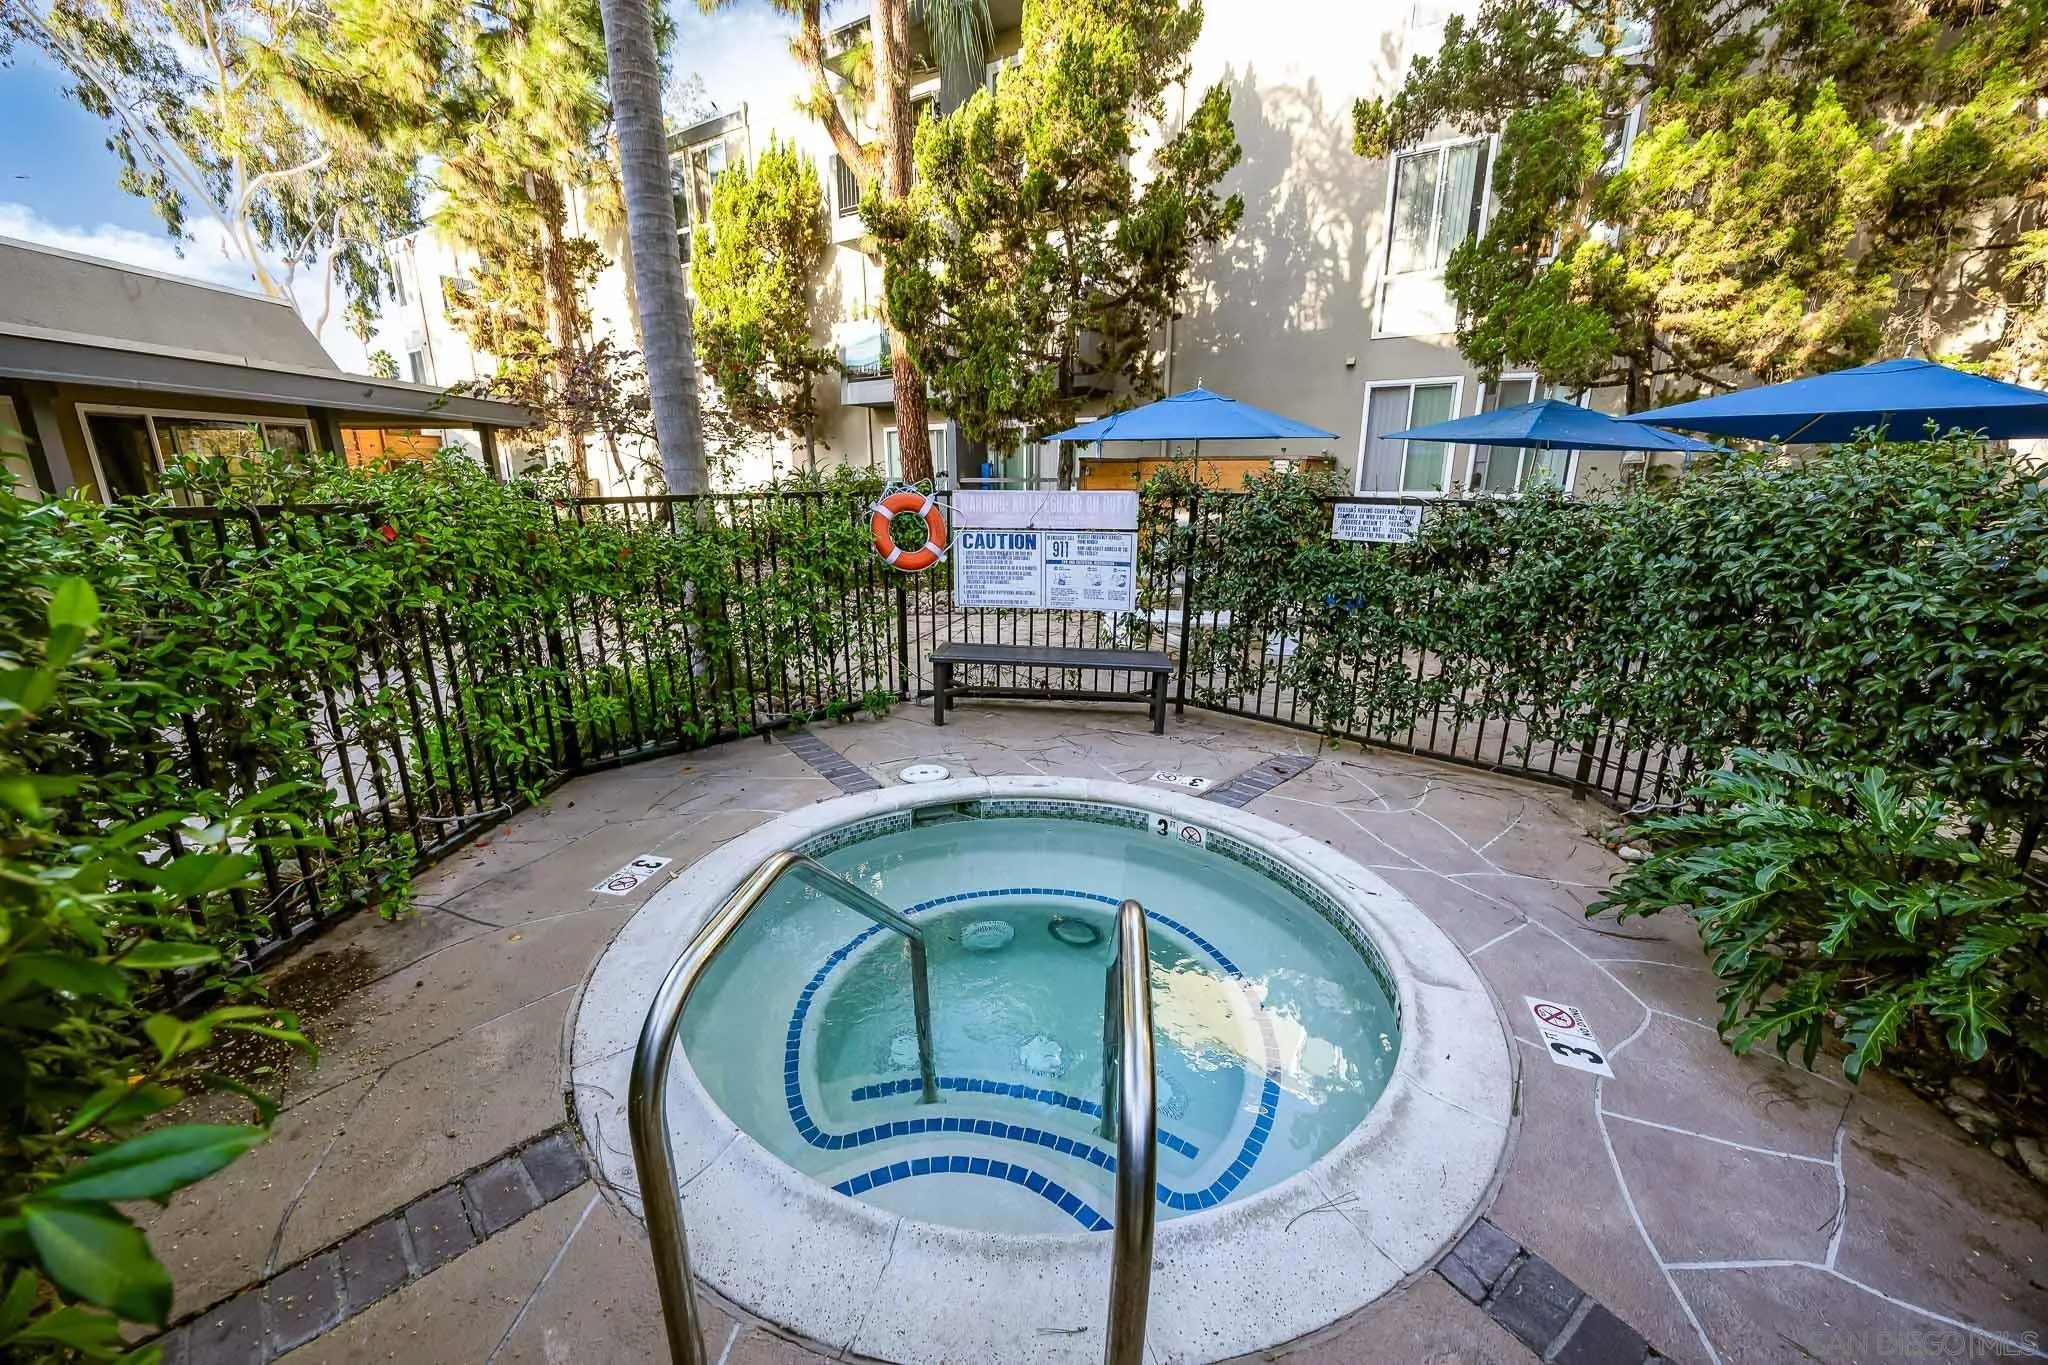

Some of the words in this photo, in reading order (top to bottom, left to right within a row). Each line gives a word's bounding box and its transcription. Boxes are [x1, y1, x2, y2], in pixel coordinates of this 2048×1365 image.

[962, 533, 1037, 550] CAUTION
[1052, 541, 1069, 558] 911
[1189, 778, 1204, 787] 3
[1157, 818, 1168, 836] 3
[631, 860, 663, 869] 3
[1550, 1042, 1604, 1065] 3
